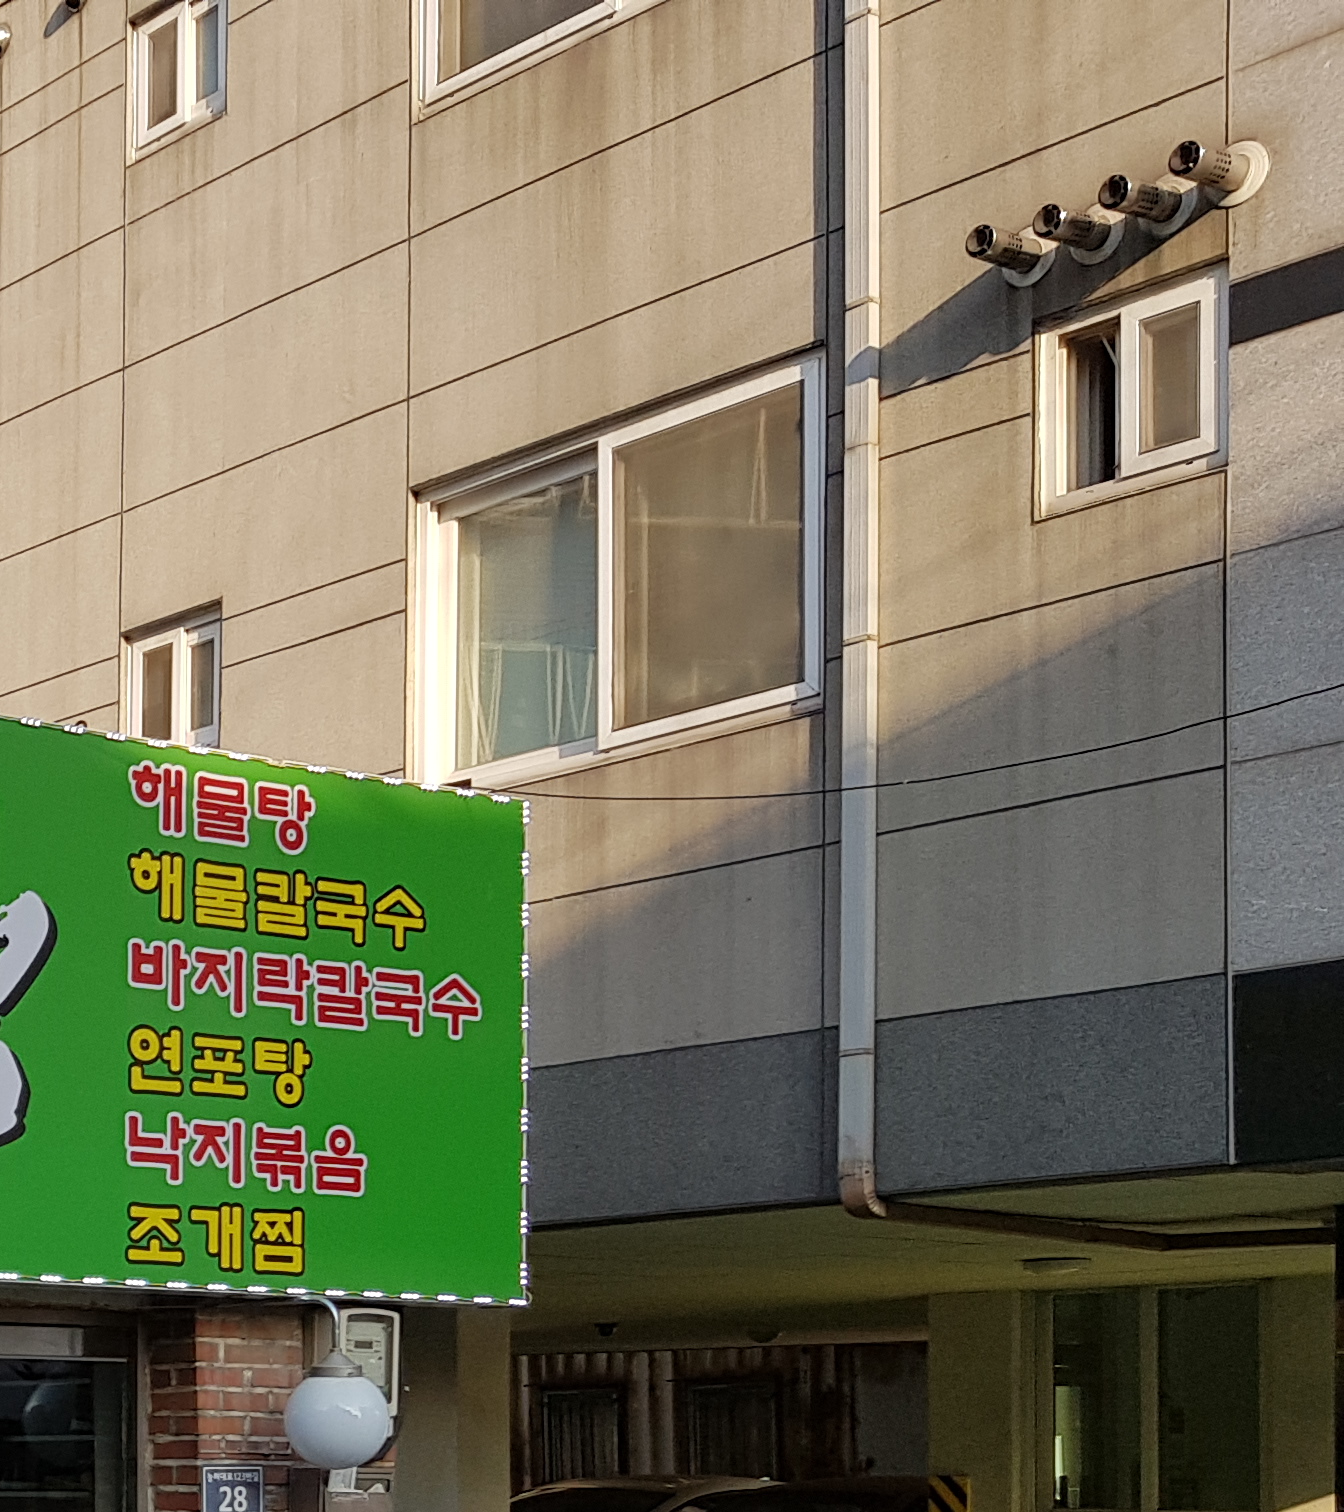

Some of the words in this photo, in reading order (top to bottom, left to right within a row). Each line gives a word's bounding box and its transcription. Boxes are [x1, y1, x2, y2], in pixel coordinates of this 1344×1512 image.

[128, 761, 316, 854] 해물탕
[128, 849, 427, 950] 해물칼국수
[127, 939, 482, 1040] 바지락칼국수
[127, 1025, 313, 1107] 연포탕
[125, 1111, 368, 1197] 낙지볶음
[126, 1202, 306, 1277] 조개찜
[219, 1486, 247, 1512] 28
